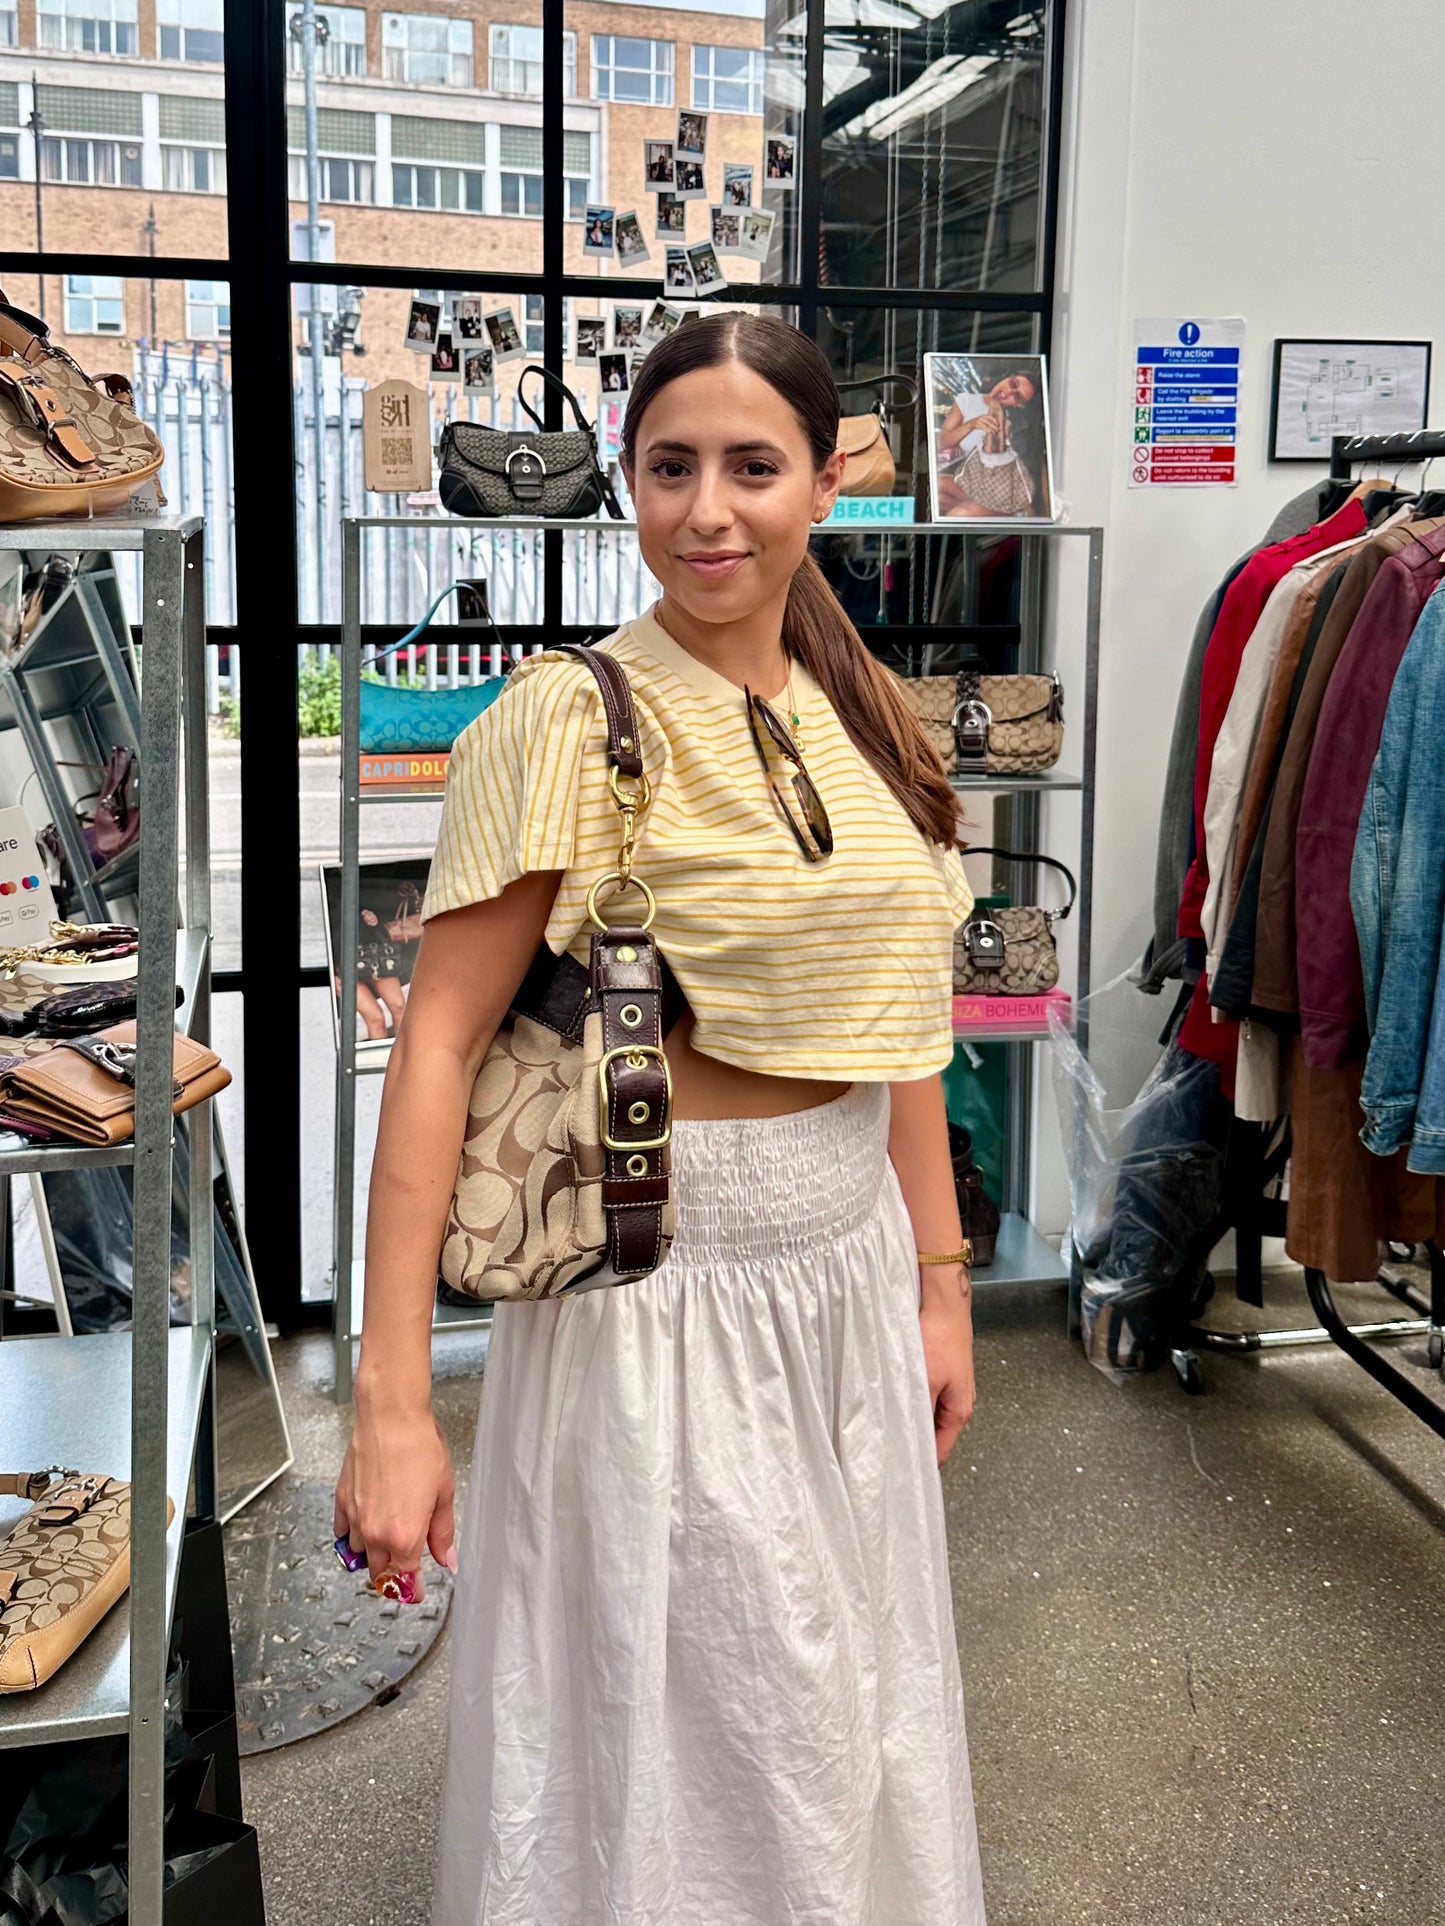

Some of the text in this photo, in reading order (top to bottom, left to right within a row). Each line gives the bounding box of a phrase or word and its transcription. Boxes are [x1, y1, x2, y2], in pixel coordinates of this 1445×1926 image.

[1163, 348, 1214, 358] Fire action
[833, 502, 904, 518] BEACH
[985, 1003, 1046, 1018] BOHEMI
